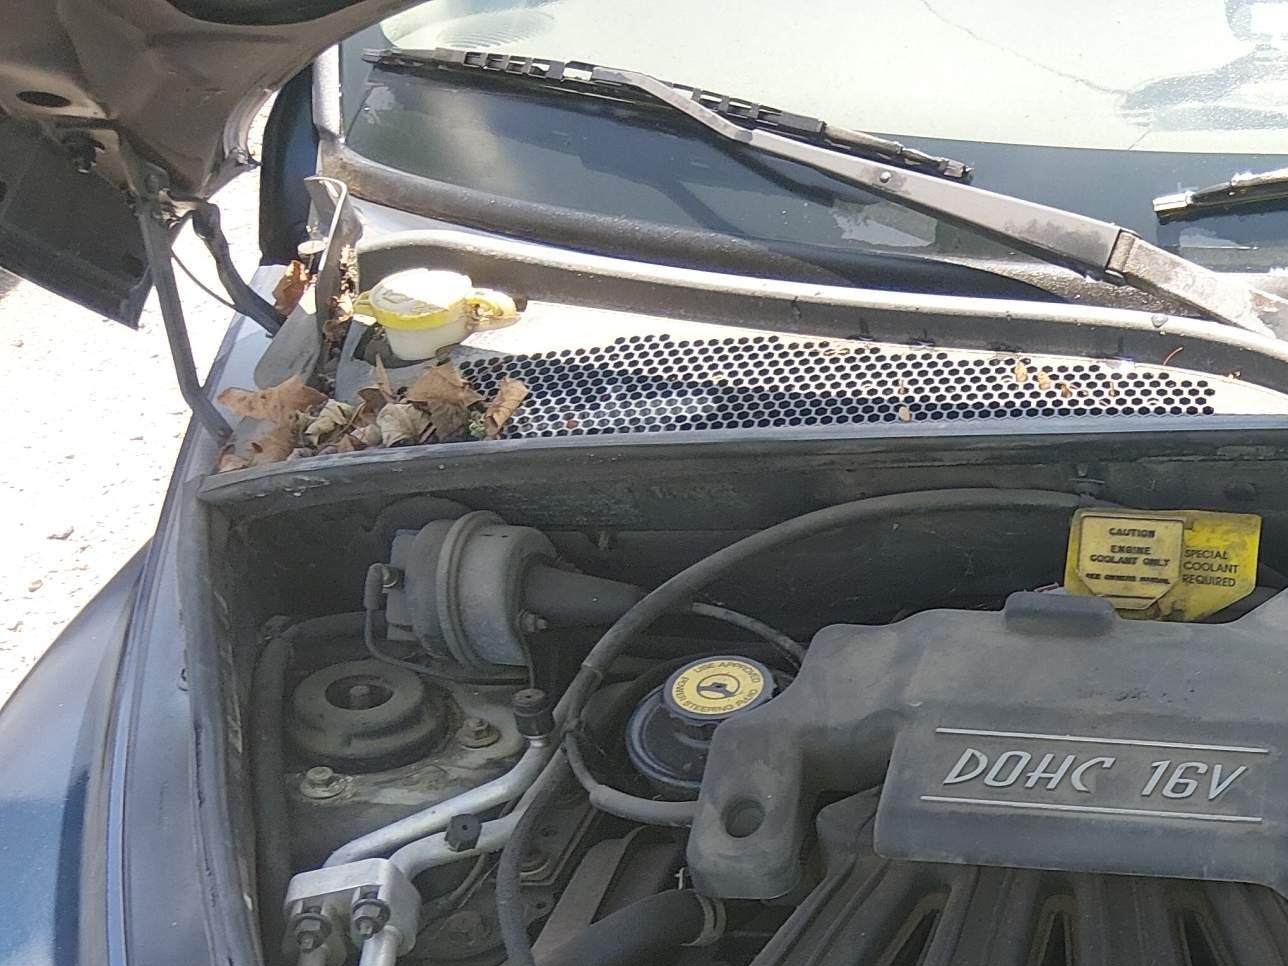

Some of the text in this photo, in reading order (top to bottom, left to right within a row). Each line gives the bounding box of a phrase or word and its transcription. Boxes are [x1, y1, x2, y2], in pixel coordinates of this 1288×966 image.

[1109, 527, 1155, 537] CAUTION
[1110, 544, 1152, 554] ENGINE
[1184, 549, 1228, 560] SPECIAL
[1090, 554, 1138, 565] COOLANT
[1183, 561, 1239, 574] COOLANT
[1182, 574, 1236, 587] REQUIRED
[718, 661, 761, 683] APPROVED
[943, 747, 1248, 800] DOHC 16V
